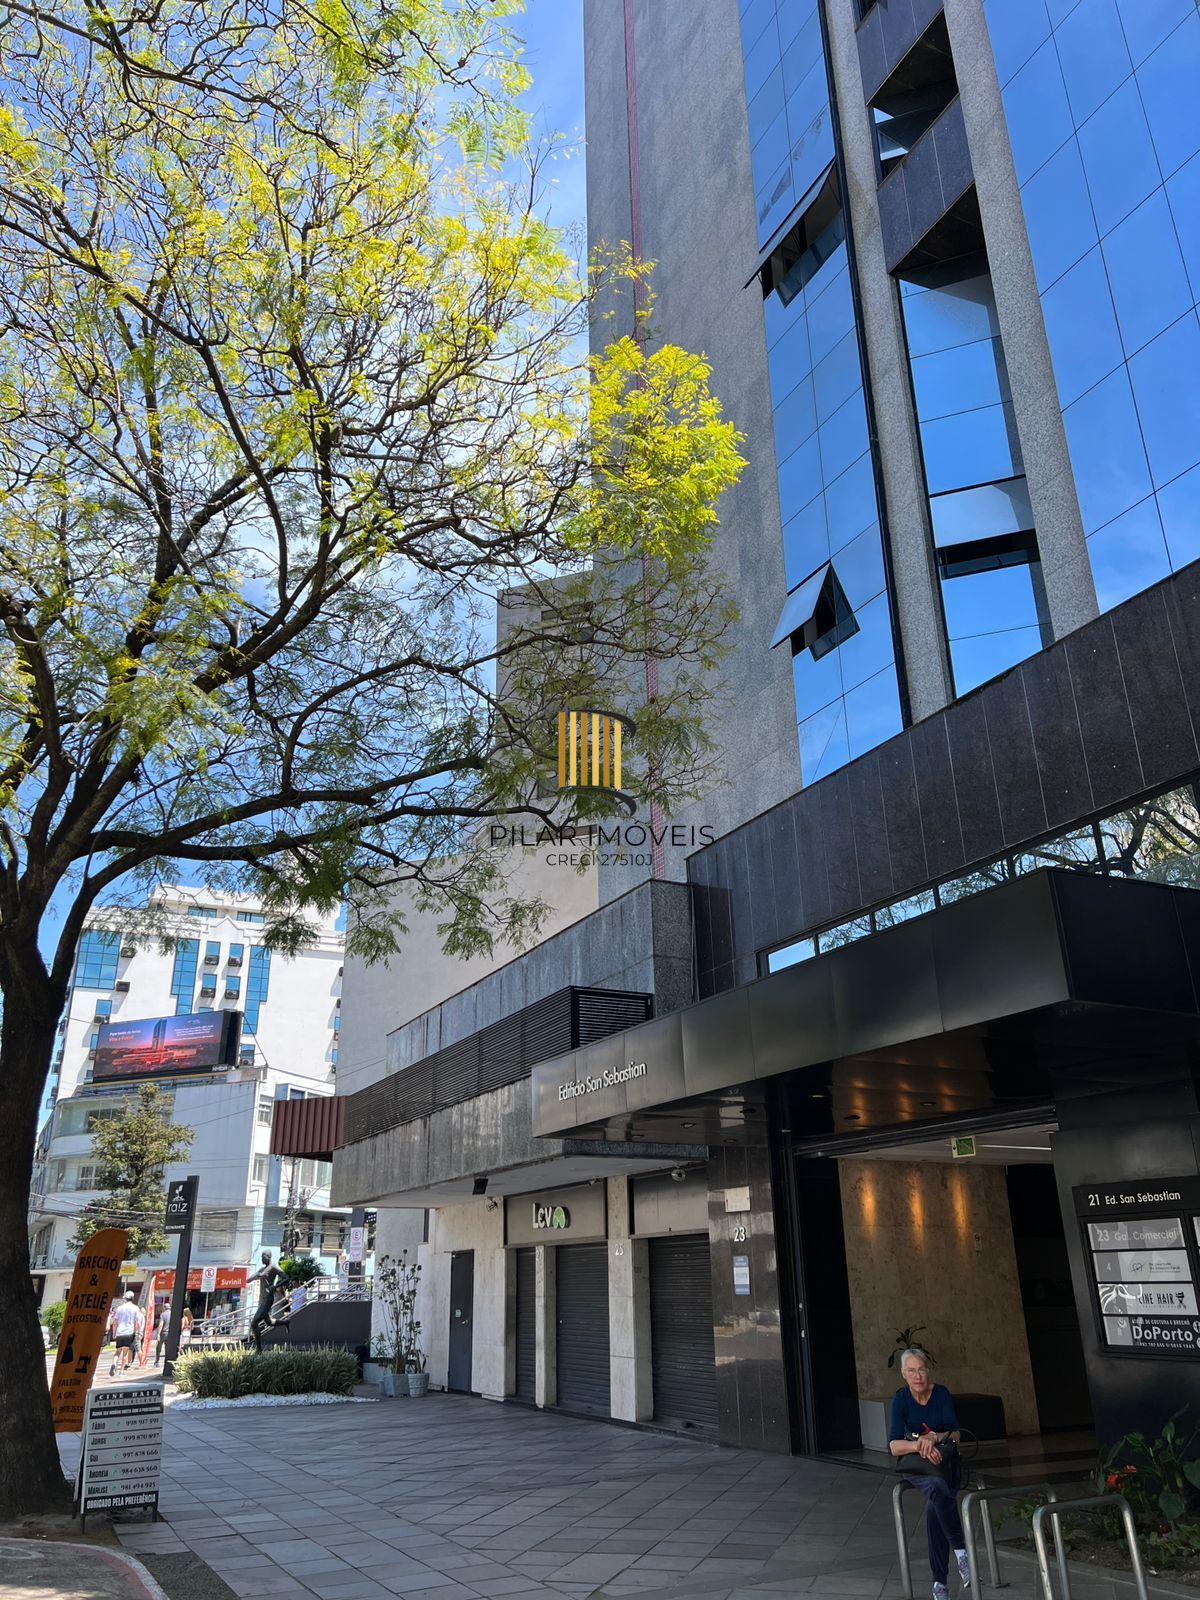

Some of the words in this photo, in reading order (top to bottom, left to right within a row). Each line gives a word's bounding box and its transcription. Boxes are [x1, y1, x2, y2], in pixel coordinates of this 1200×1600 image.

[586, 1076, 602, 1093] San
[603, 1061, 646, 1087] Sebastian
[1088, 1194, 1100, 1206] 21
[1105, 1195, 1118, 1205] Ed.
[1120, 1194, 1135, 1204] San
[1137, 1191, 1181, 1202] Sebastian
[734, 1227, 746, 1242] 23
[1096, 1230, 1110, 1242] 23
[1133, 1230, 1177, 1241] Comercial
[615, 1243, 624, 1256] 25
[79, 1255, 118, 1271] BRECHÓ
[89, 1273, 98, 1286] &
[221, 1278, 242, 1286] Suvinil
[72, 1291, 109, 1311] ATELIÊ
[1156, 1293, 1175, 1305] HAIR
[1132, 1325, 1193, 1341] DoPorto
[86, 1498, 112, 1509] OBRIGADO
[112, 1497, 124, 1507] PELA
[125, 1493, 156, 1505] PREFERÊNCIA
